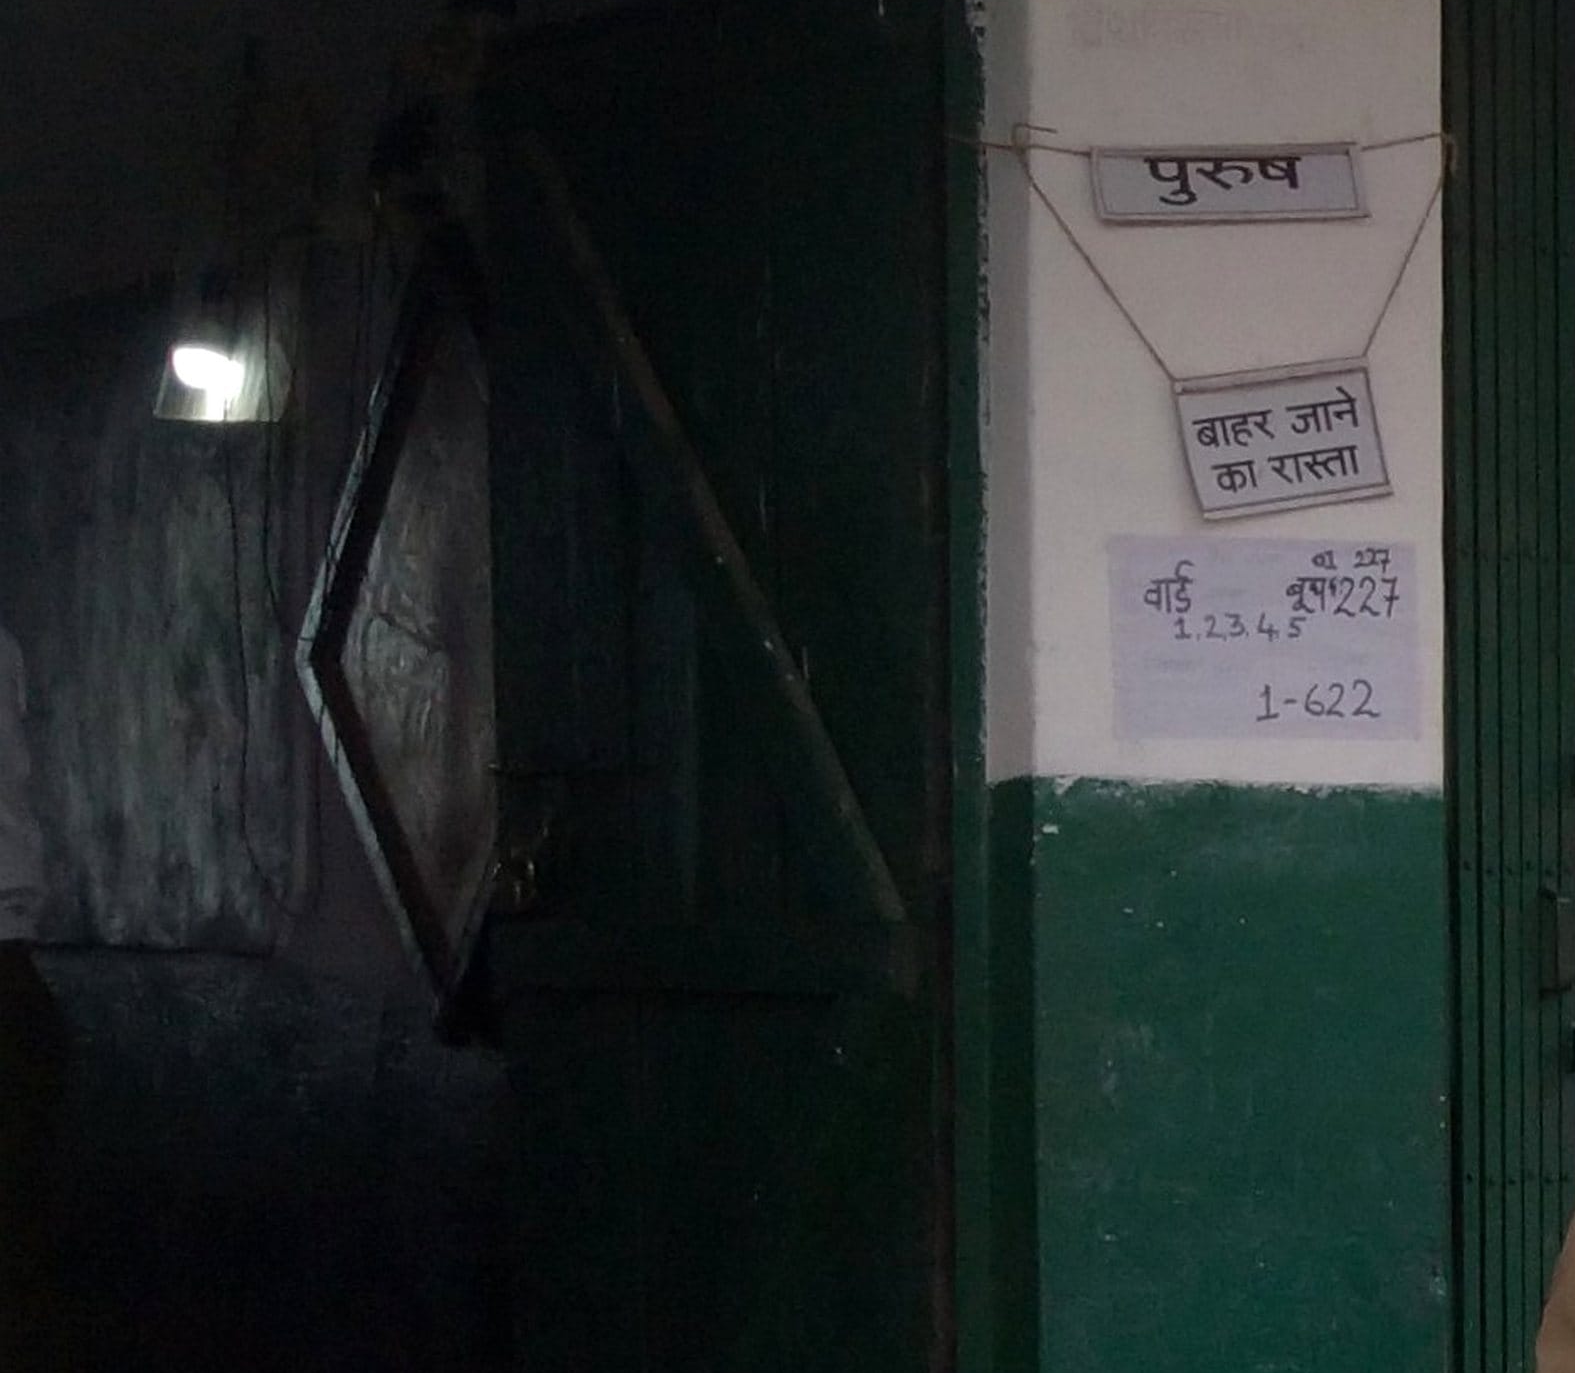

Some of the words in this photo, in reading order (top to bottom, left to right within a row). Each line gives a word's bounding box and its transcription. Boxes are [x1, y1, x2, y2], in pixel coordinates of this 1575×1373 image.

[1143, 153, 1306, 206] पुरुष
[1193, 409, 1273, 450] बाहर
[1289, 386, 1361, 435] जाने
[1212, 460, 1259, 495] का
[1269, 443, 1361, 485] रास्ता
